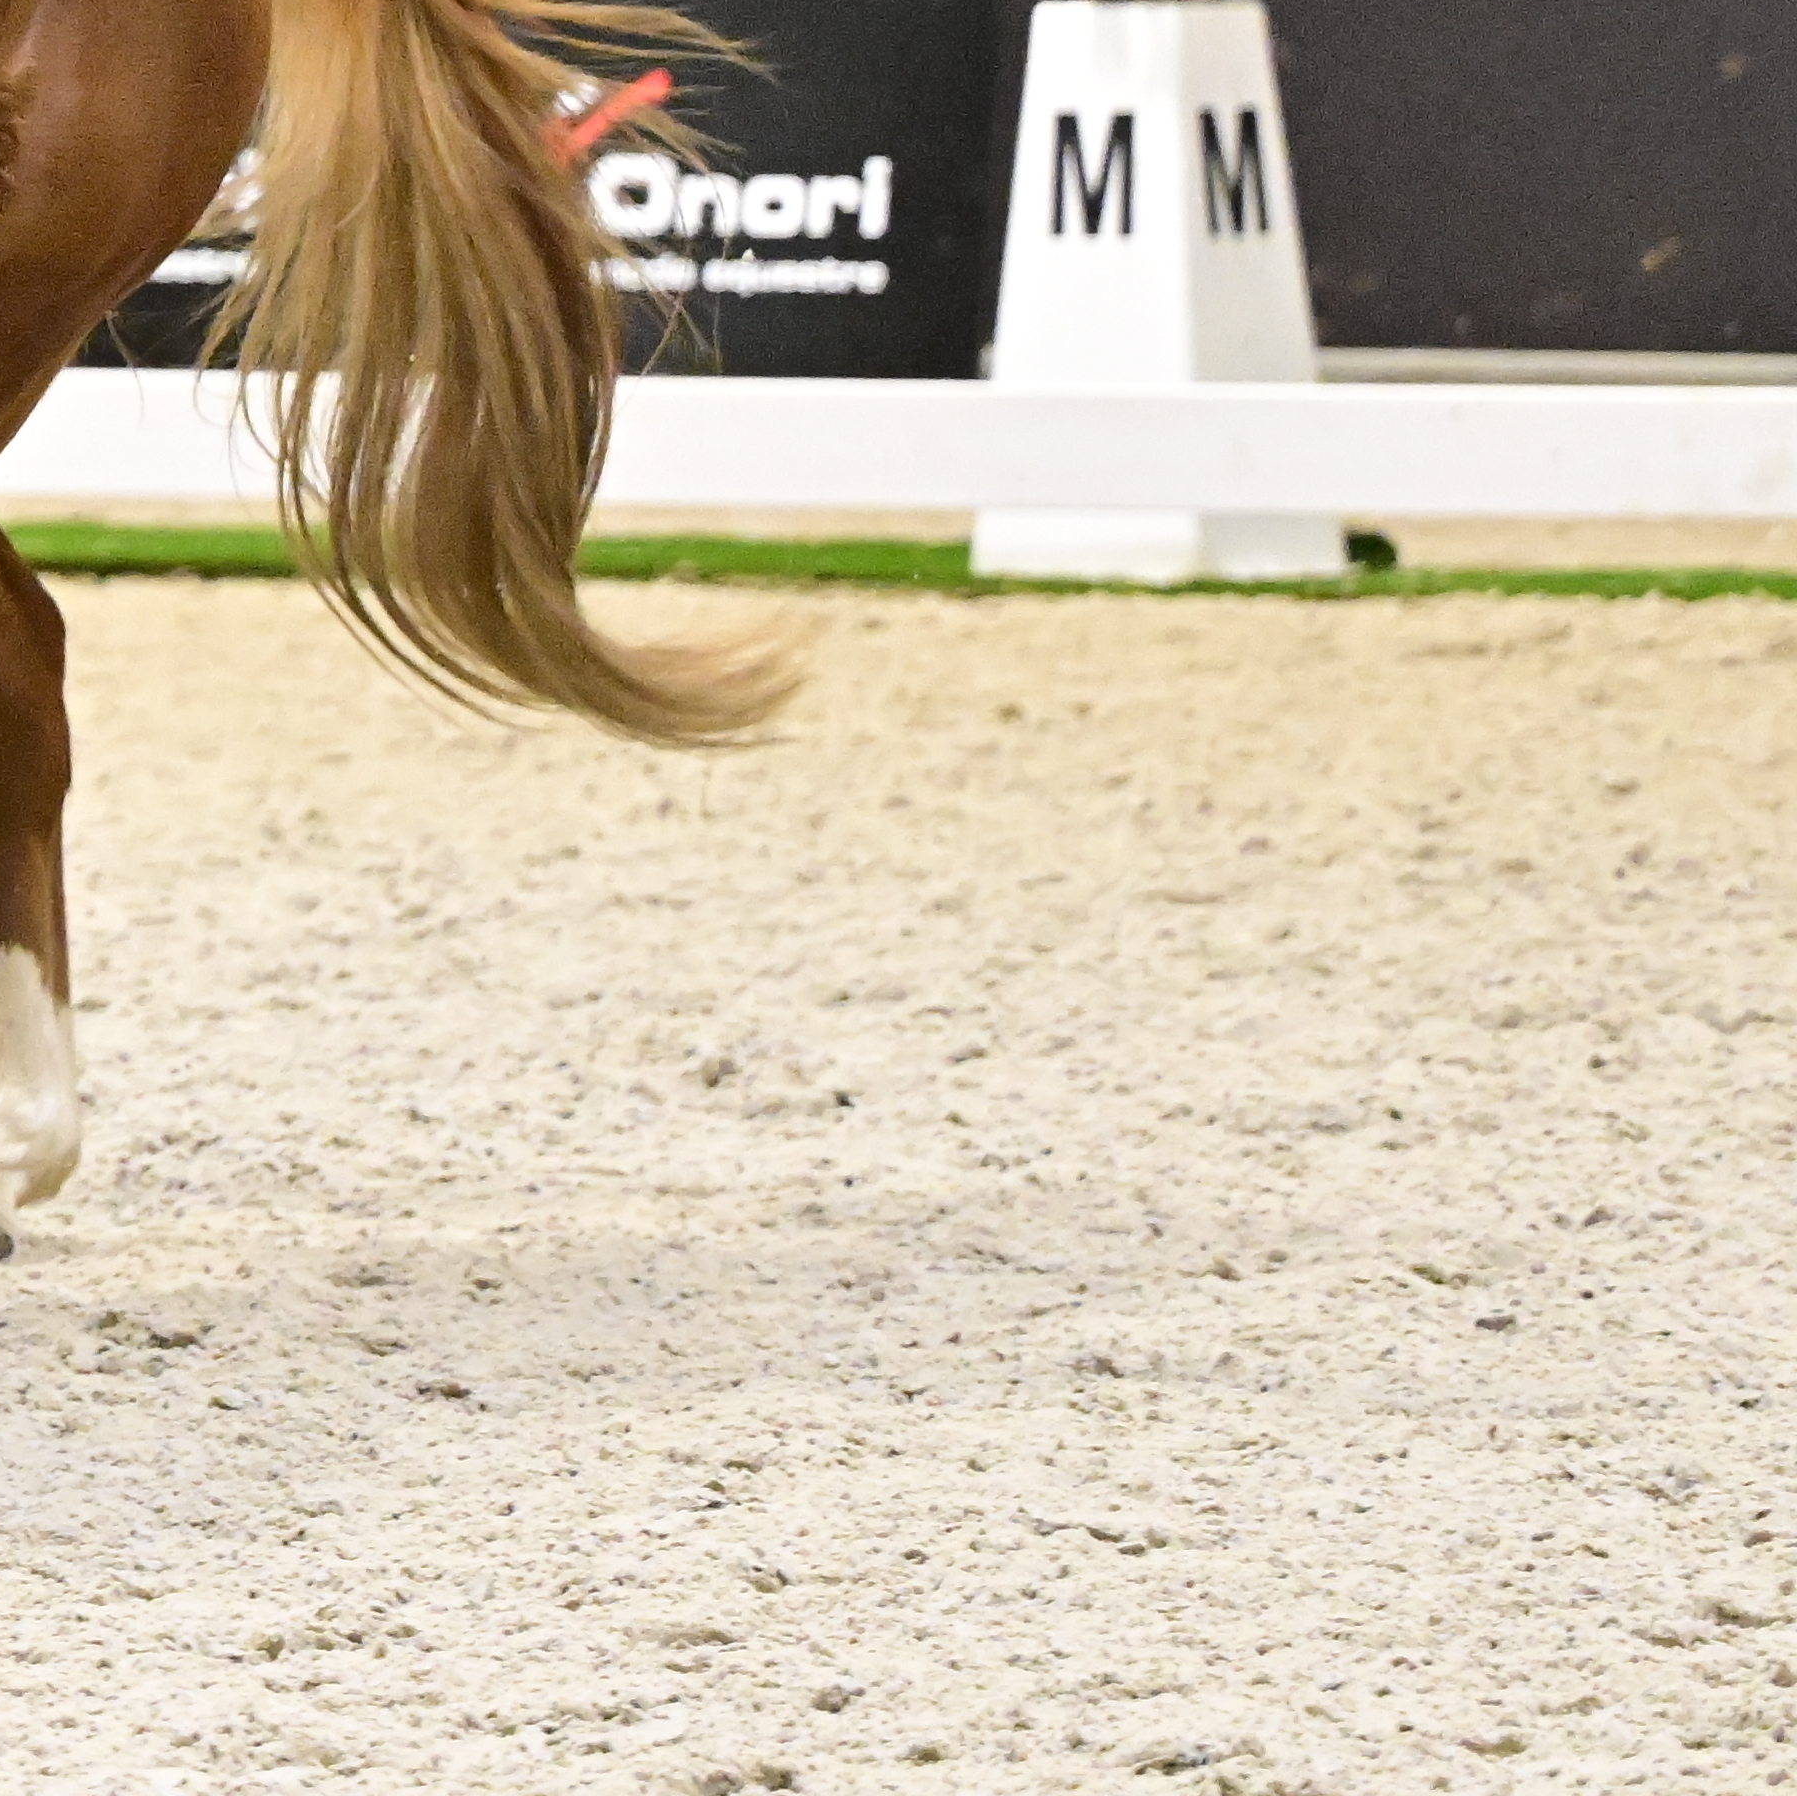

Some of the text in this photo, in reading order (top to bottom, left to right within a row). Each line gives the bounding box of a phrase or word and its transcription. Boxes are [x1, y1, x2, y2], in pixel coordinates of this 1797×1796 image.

[588, 151, 892, 240] Onori
[1053, 112, 1134, 237] M
[1201, 109, 1269, 235] M
